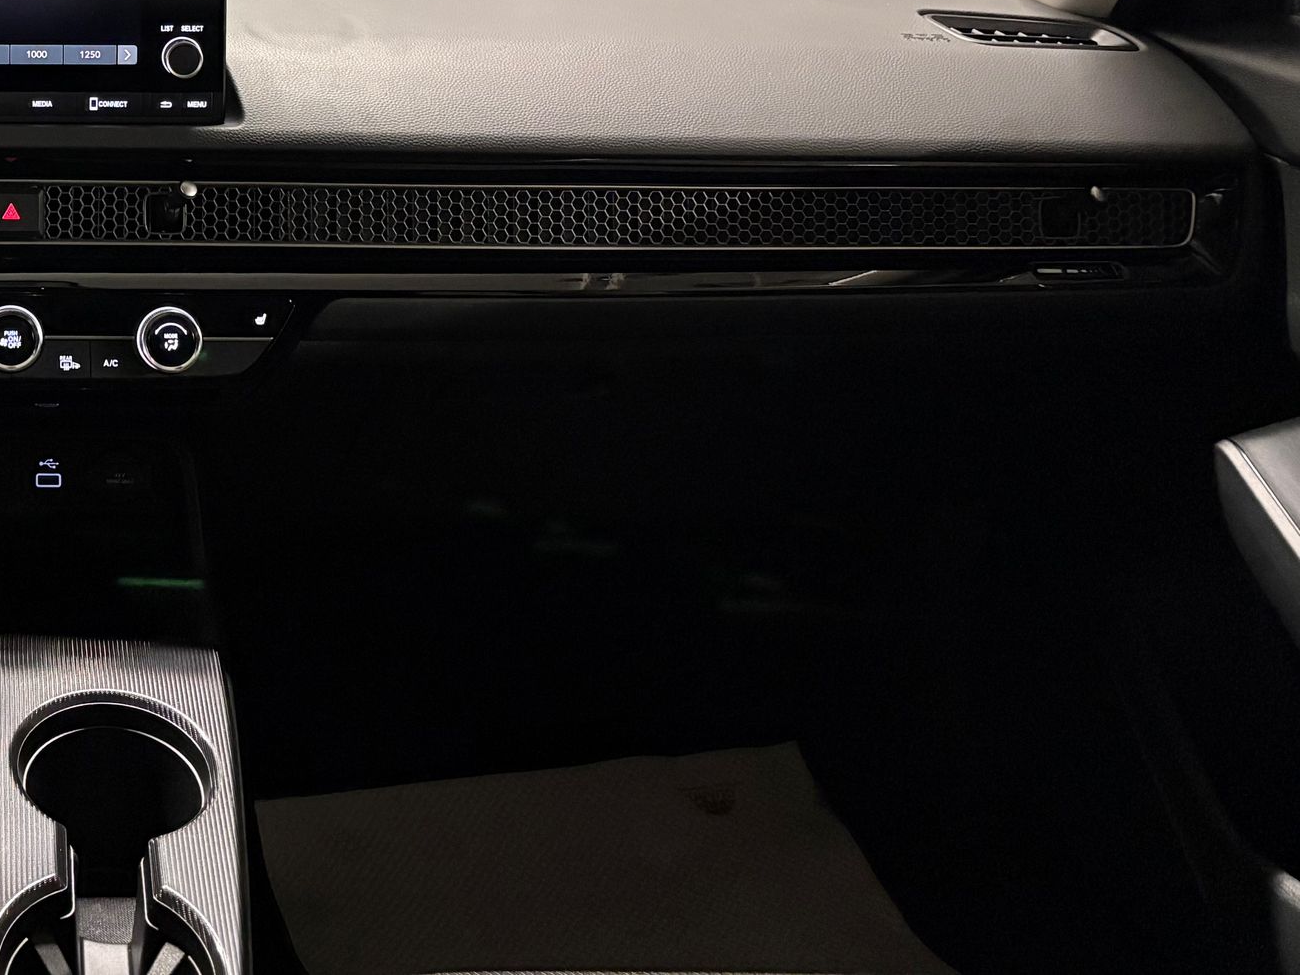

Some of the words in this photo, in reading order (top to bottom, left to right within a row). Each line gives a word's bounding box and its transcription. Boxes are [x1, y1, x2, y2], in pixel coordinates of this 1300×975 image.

[181, 25, 204, 33] SELECT
[26, 50, 48, 59] 1000
[79, 50, 101, 59] 1250
[32, 100, 53, 108] MEDIA
[98, 100, 128, 108] CONNECT
[187, 100, 208, 108] MENU
[7, 341, 22, 349] OFF
[103, 359, 119, 368] A/C
